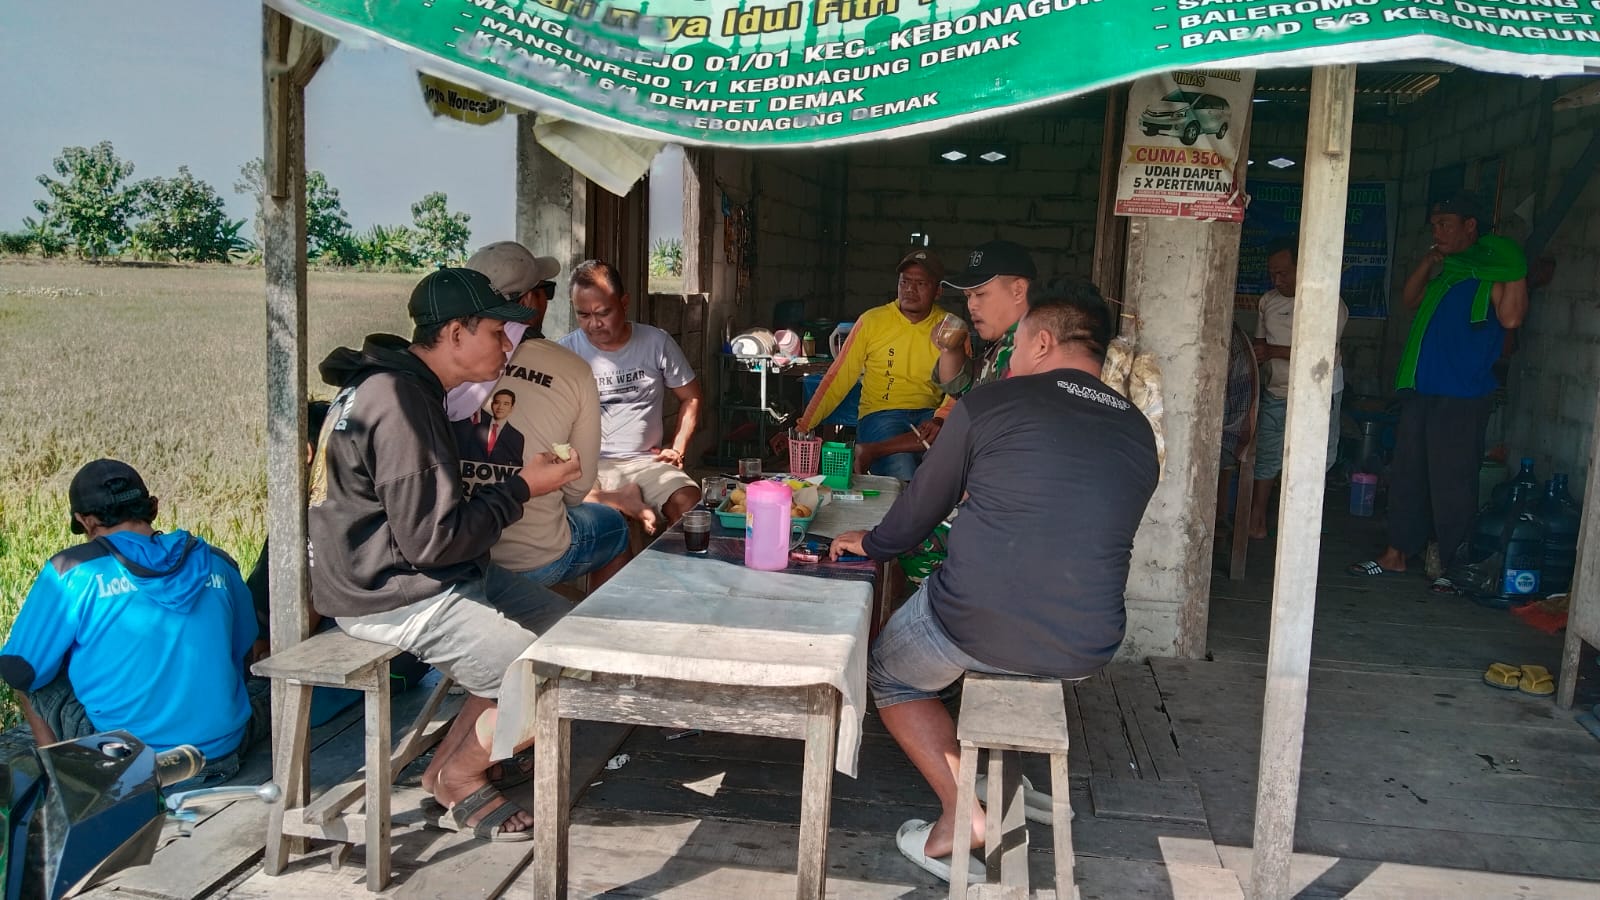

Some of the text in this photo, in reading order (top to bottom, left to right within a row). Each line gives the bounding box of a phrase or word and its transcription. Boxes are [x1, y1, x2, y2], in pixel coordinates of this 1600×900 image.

[721, 1, 802, 37] Idul
[1455, 0, 1595, 24] DEMPET
[1181, 21, 1301, 48] BABAD
[1313, 12, 1370, 30] 5/3
[481, 17, 670, 88] MANGUNREJO
[681, 80, 717, 93] 1/1
[729, 58, 910, 93] KEBONAGUNG
[920, 32, 1020, 67] DEMAK
[705, 49, 790, 72] 01/01
[804, 40, 876, 63] KEC.
[649, 92, 761, 113] DEMPET
[768, 88, 865, 112] DEMAK
[1136, 147, 1187, 164] CUMA
[1145, 166, 1222, 180] UDAH DAPET
[1133, 178, 1232, 193] 5 X PERTEMUAN
[616, 370, 645, 384] WEAR
